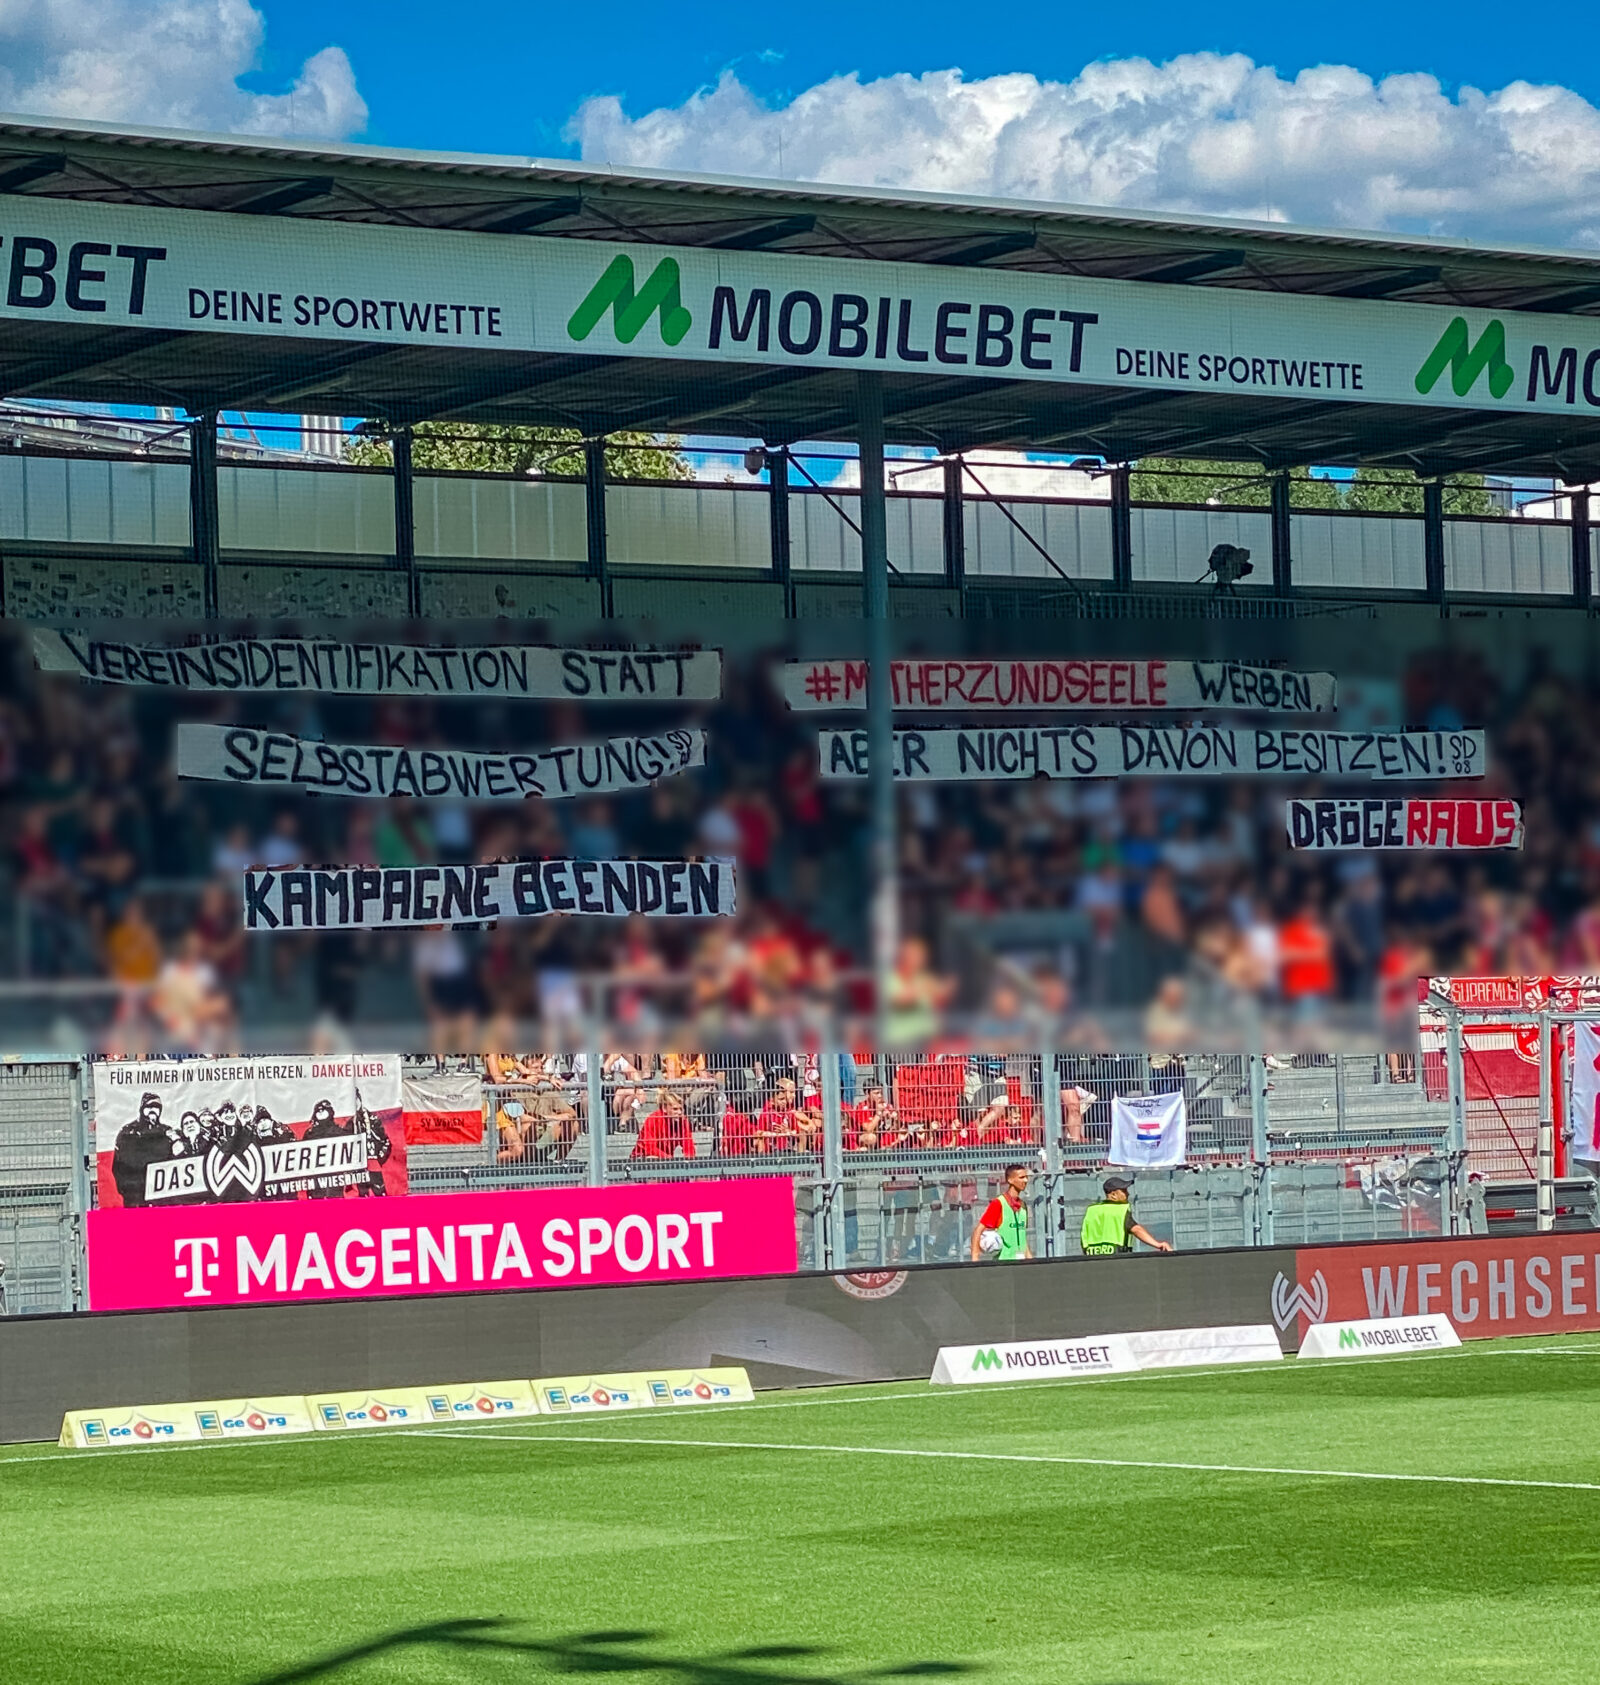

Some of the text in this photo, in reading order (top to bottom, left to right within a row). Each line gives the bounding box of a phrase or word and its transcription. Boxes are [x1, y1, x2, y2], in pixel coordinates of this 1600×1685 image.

[0, 236, 502, 336] BET DEINE SPORTWETTE
[708, 286, 1099, 373] MOBILEBET
[1116, 347, 1190, 380] DEINE
[1198, 355, 1363, 390] SPORTWETTE
[62, 637, 694, 696] VEREINSIDENTIFIKATION STATT
[805, 660, 1321, 711] #MTHERZUNDSEELE WERBEN.
[224, 728, 671, 797] SELBSTABWERTUNG!
[831, 732, 930, 777] ABR
[957, 727, 1098, 775] NICHTS
[1122, 729, 1237, 772] DAVON
[1255, 731, 1446, 776] BESITZEN!
[246, 861, 719, 930] KAMPAGNE BEENDEN
[110, 1067, 133, 1085] FÜR
[137, 1066, 178, 1084] IMMER
[182, 1067, 194, 1083] IN
[197, 1066, 254, 1082] UNSEREM
[258, 1064, 307, 1079] HERZEN.
[312, 1064, 351, 1078] DANKE
[154, 1163, 195, 1193] DAS
[265, 1184, 278, 1197] SV
[280, 1179, 315, 1194] WEHEN
[235, 1222, 534, 1294] MAGENTA
[541, 1211, 723, 1278] SPORT
[1362, 1254, 1600, 1323] WECHSE
[1006, 1346, 1110, 1368] MOBILEBET
[1361, 1326, 1438, 1347] MOBILEBET
